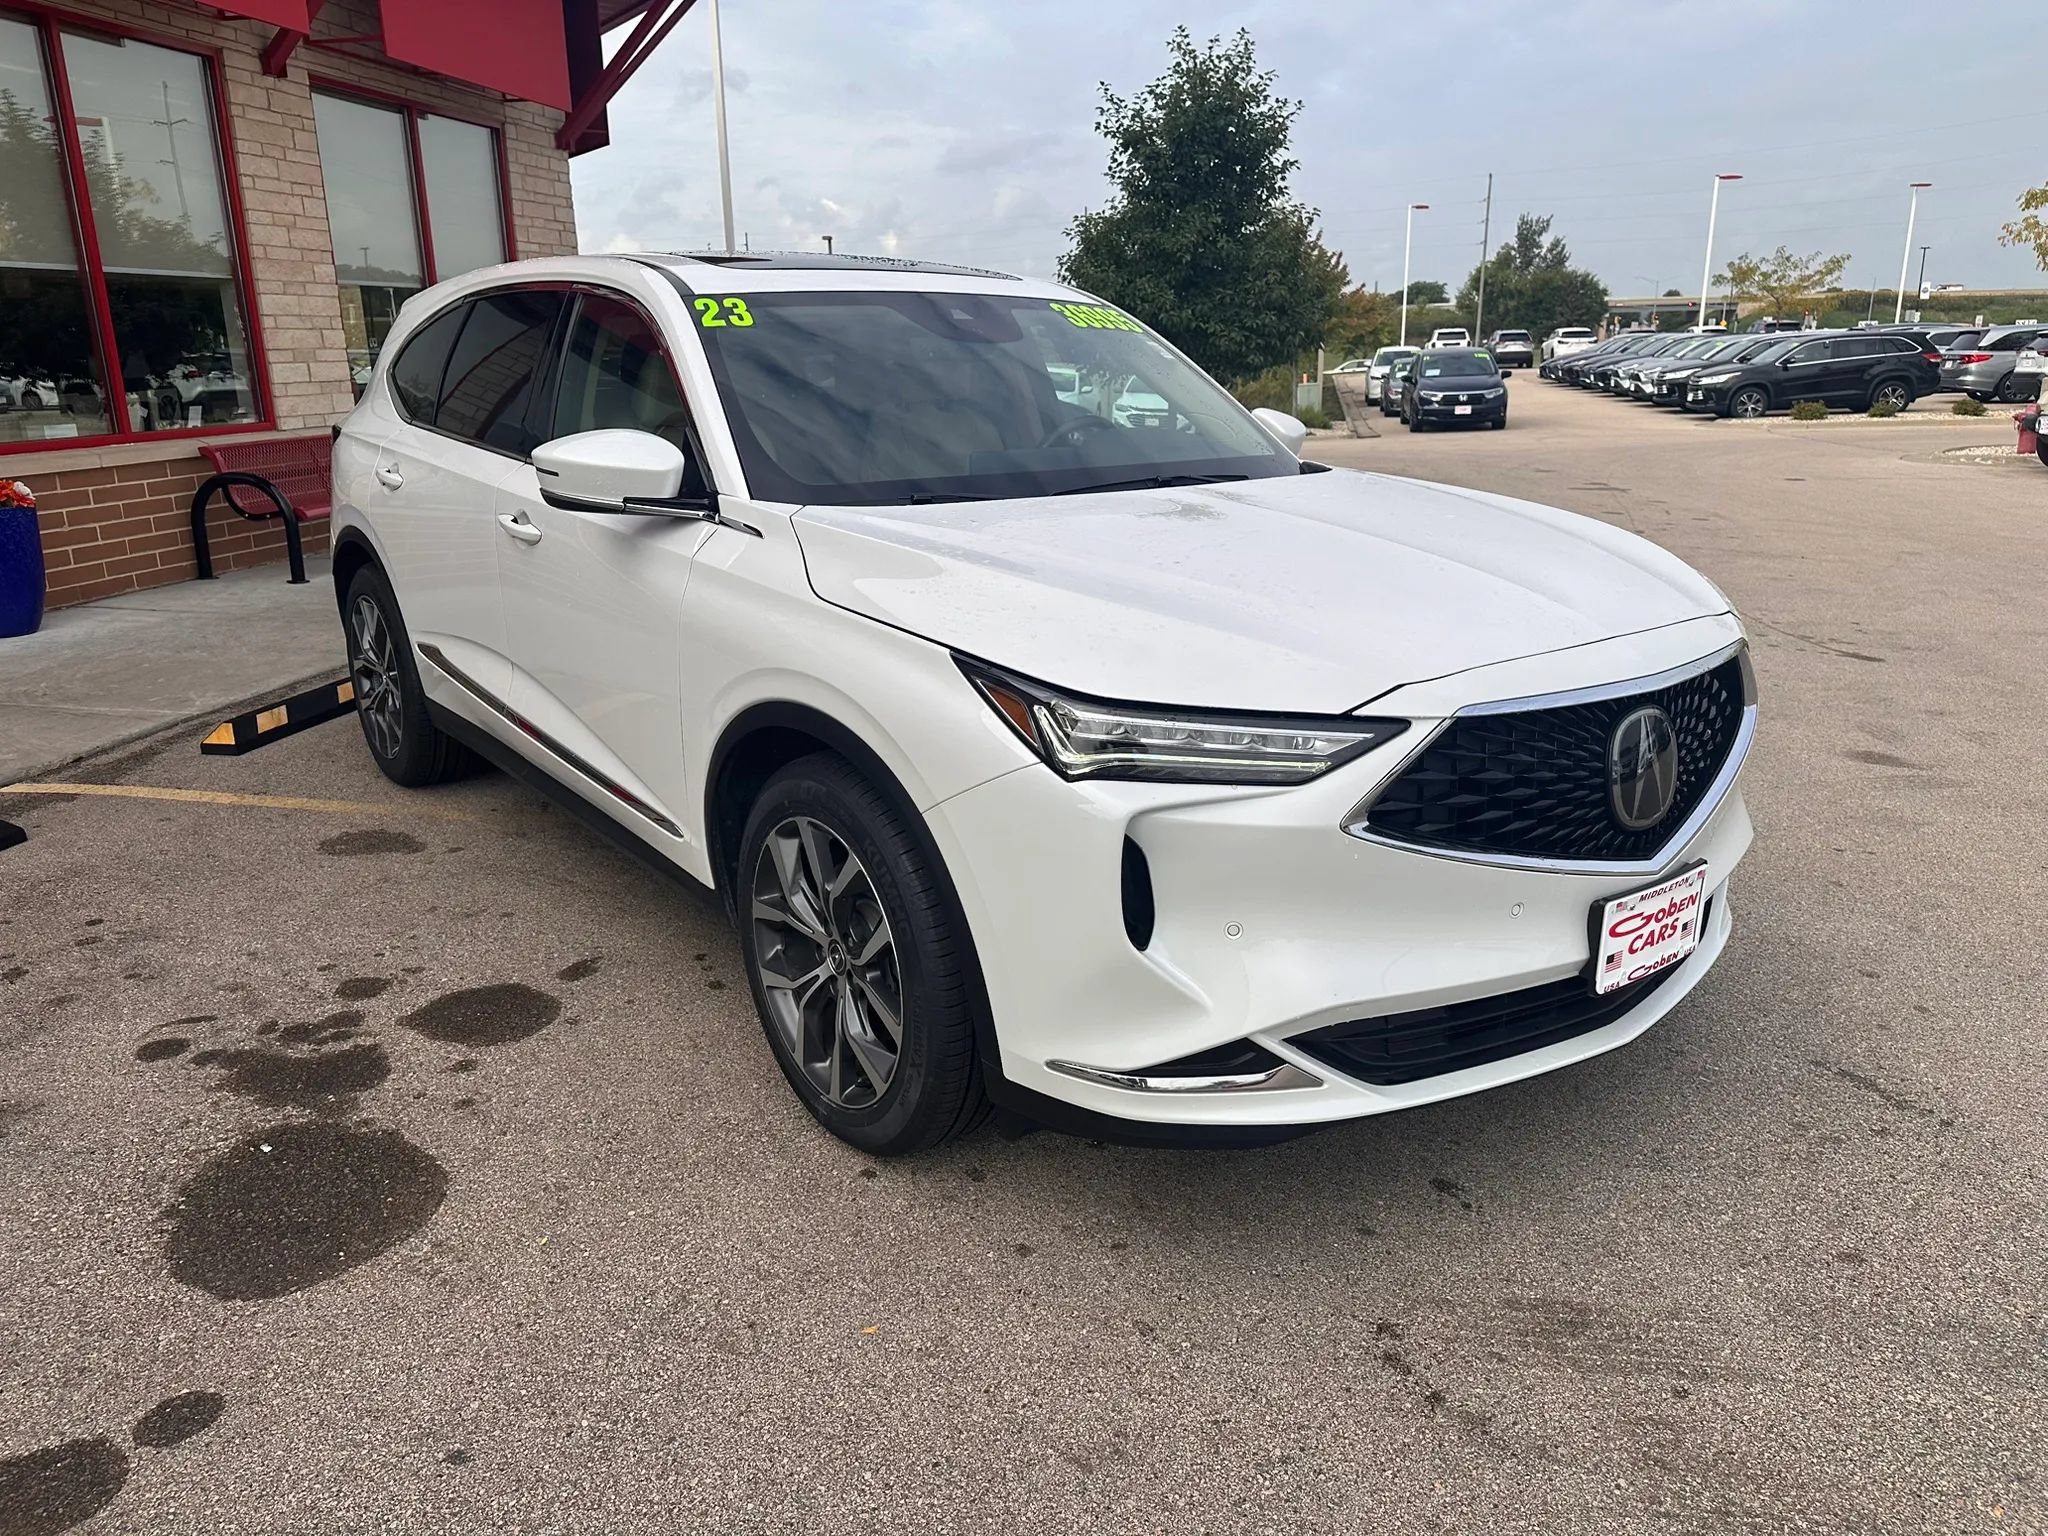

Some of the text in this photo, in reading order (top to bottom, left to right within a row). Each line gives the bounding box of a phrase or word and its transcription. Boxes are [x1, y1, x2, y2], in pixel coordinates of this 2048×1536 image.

[694, 297, 754, 327] 23
[1049, 303, 1144, 333] 36995
[1639, 876, 1690, 903] MIDDLETON
[1627, 917, 1680, 955] CARS
[1604, 981, 1620, 993] USA
